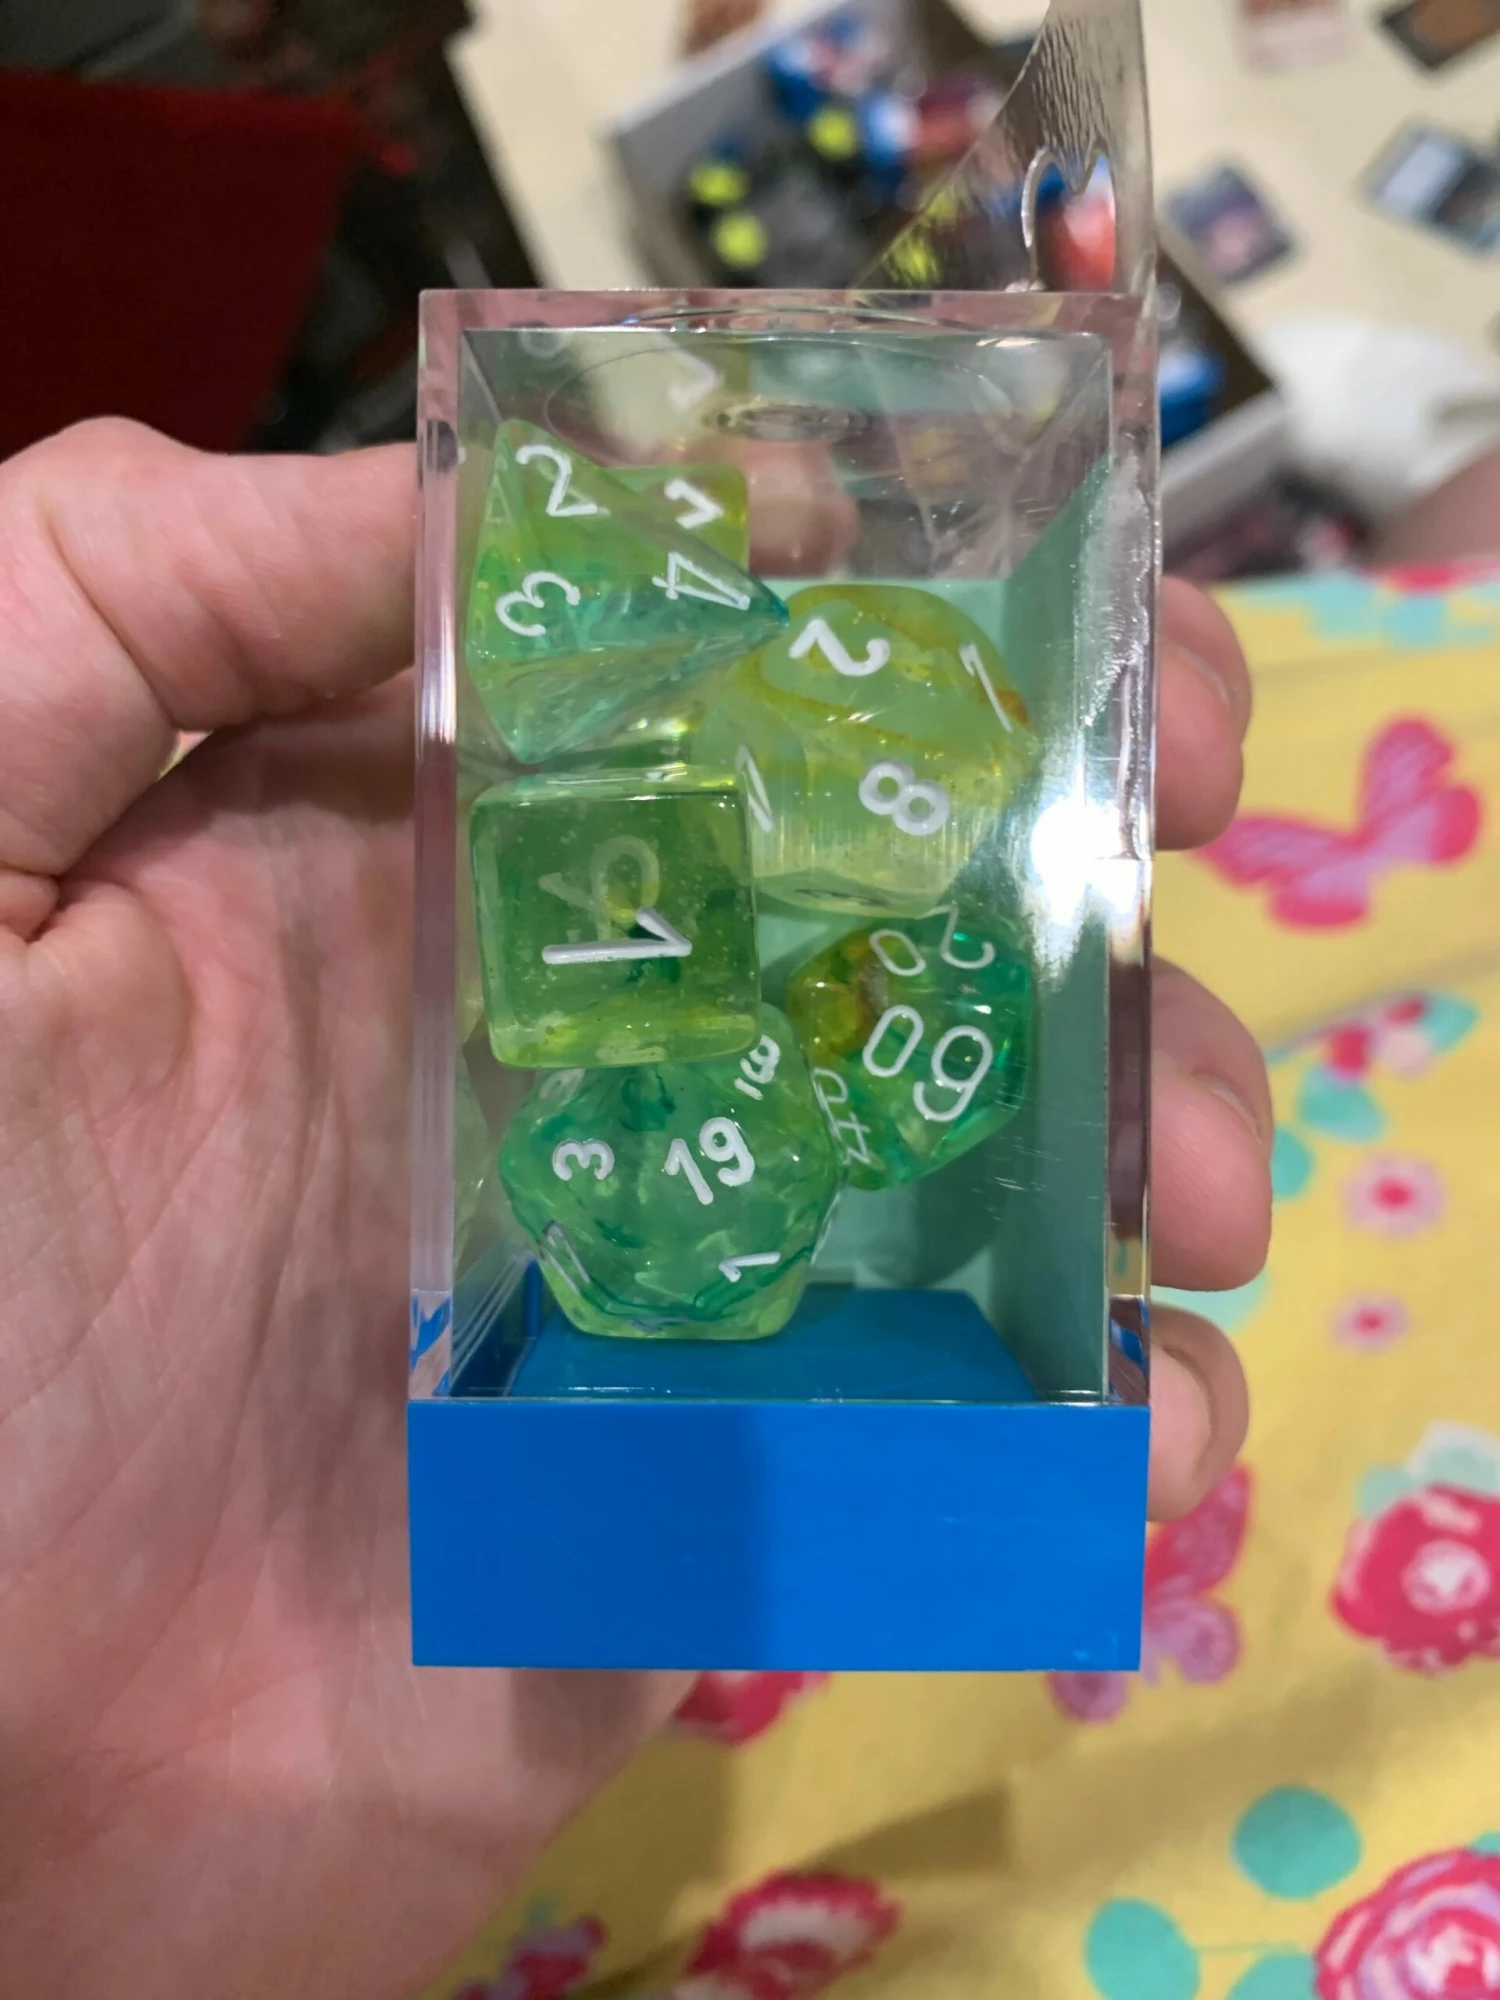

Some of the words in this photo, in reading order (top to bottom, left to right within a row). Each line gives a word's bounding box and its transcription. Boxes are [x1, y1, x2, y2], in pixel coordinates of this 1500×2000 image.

[516, 444, 599, 518] 2
[496, 571, 580, 637] 3
[652, 552, 750, 611] 4
[788, 618, 890, 677] 2
[858, 757, 951, 836] 8
[552, 1139, 615, 1182] 3
[664, 1117, 755, 1206] 19
